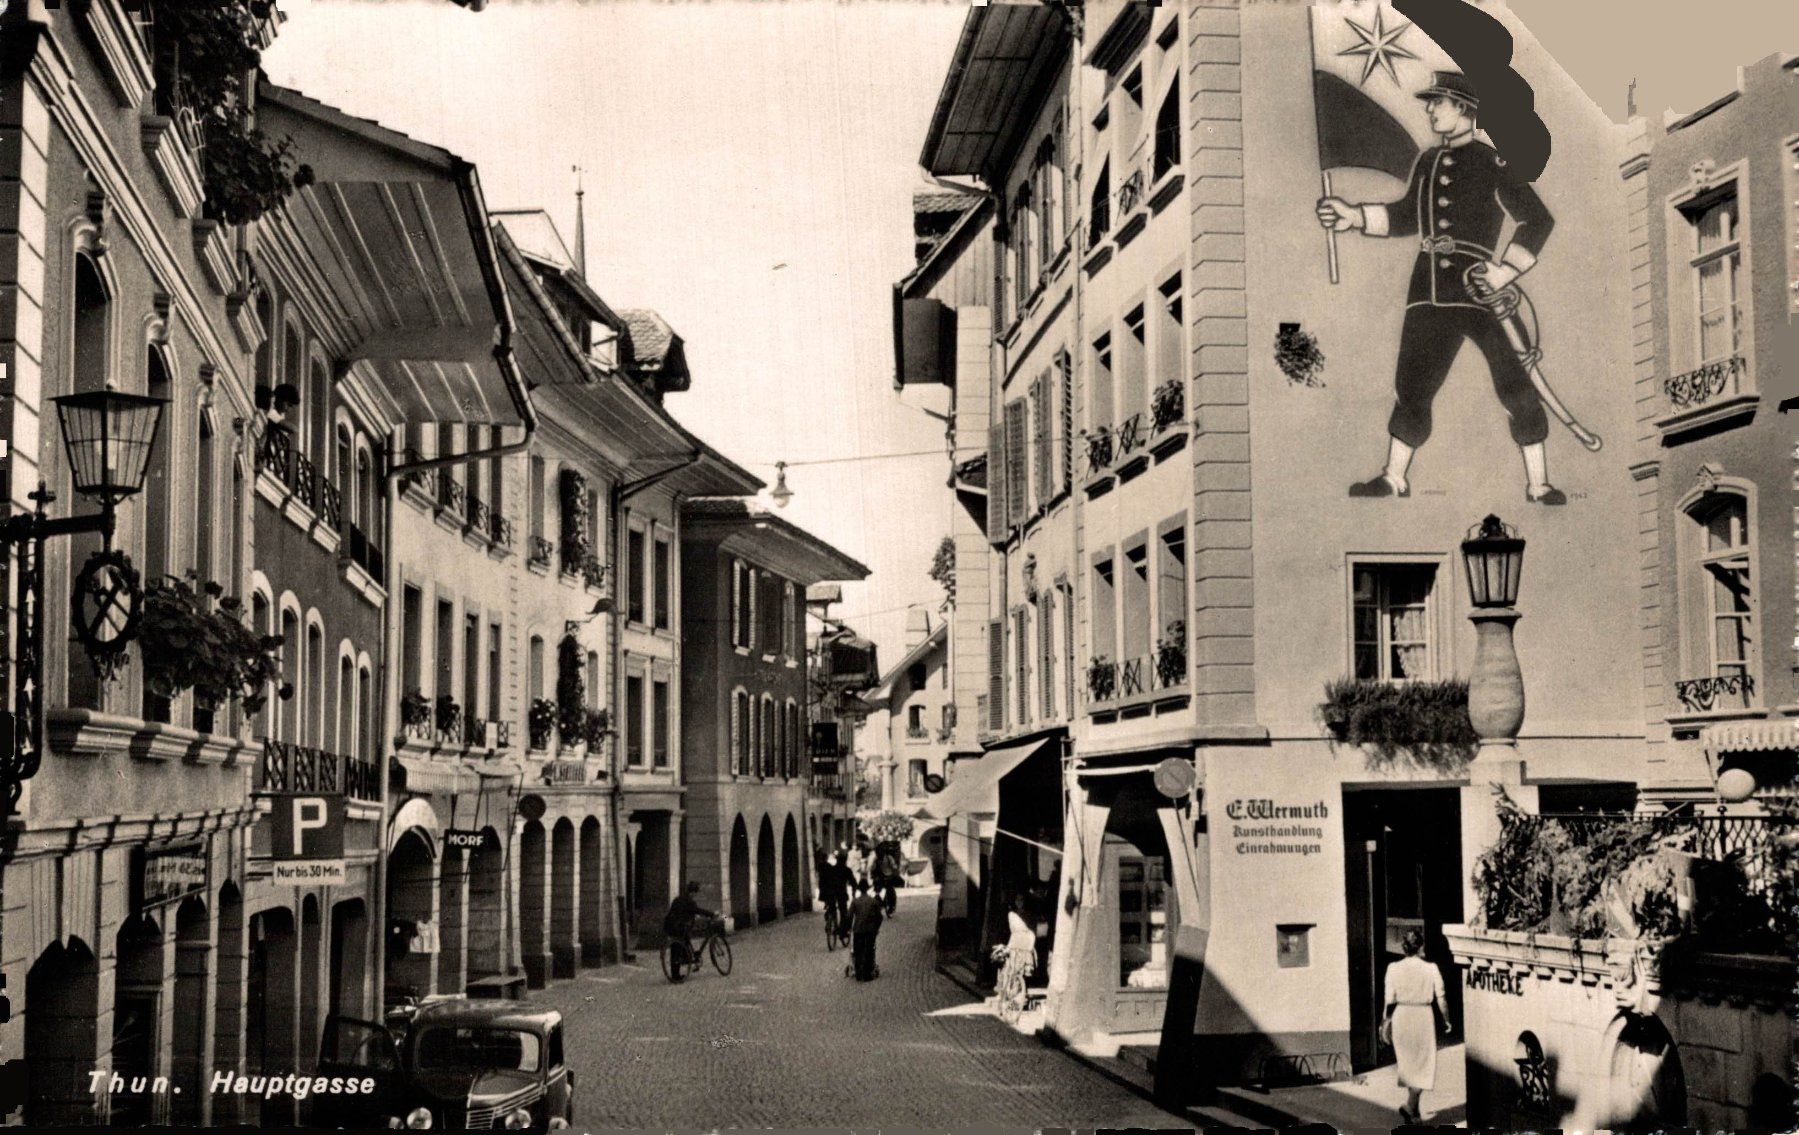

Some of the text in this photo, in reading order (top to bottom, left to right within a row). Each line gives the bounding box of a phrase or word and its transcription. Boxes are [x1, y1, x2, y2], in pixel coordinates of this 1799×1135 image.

[293, 797, 327, 855] P
[1233, 825, 1323, 839] Kunsthandlung
[448, 834, 484, 846] MORF
[1236, 842, 1321, 856] Einrahmungen
[277, 865, 343, 878] Nur bis 30 Min.
[1466, 968, 1524, 997] APOTHEKE
